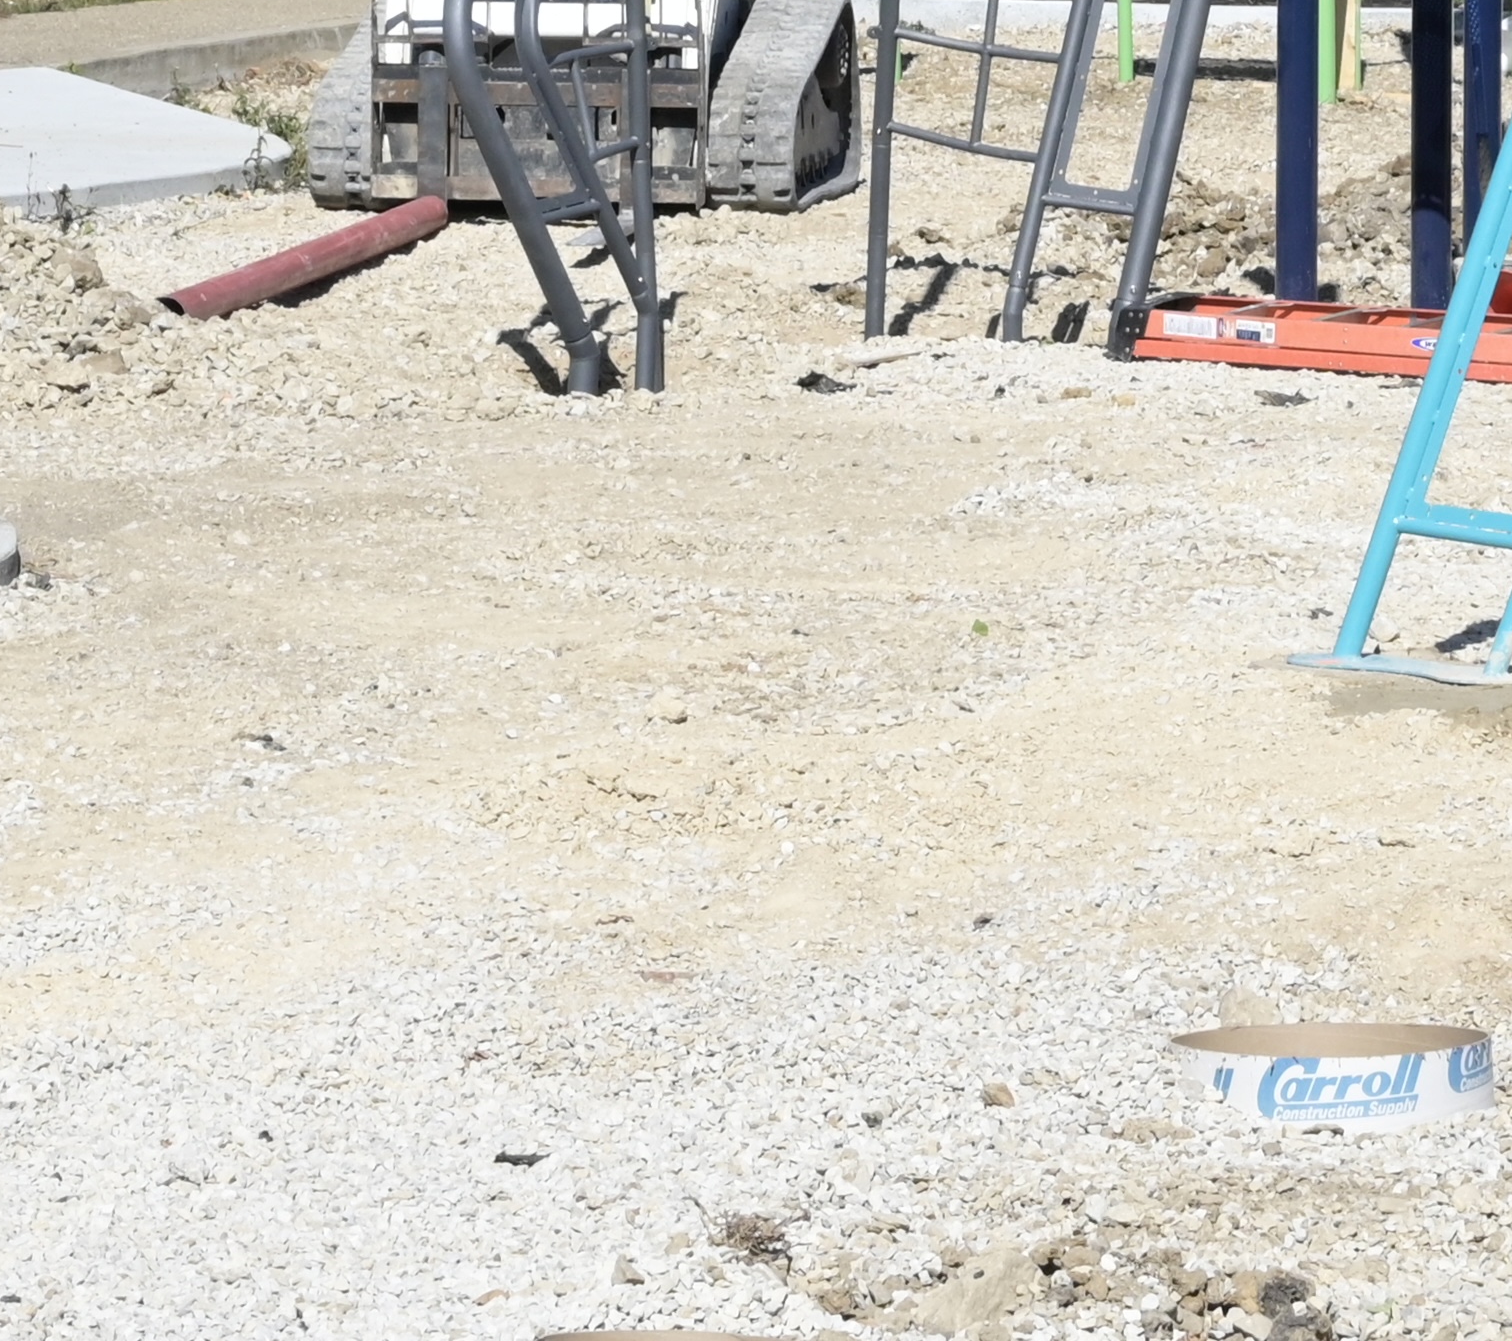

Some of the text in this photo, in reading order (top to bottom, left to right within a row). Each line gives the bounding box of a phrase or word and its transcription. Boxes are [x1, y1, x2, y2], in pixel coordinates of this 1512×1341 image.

[1257, 1052, 1426, 1121] Carroll
[1272, 1096, 1416, 1121] Construction Supply
